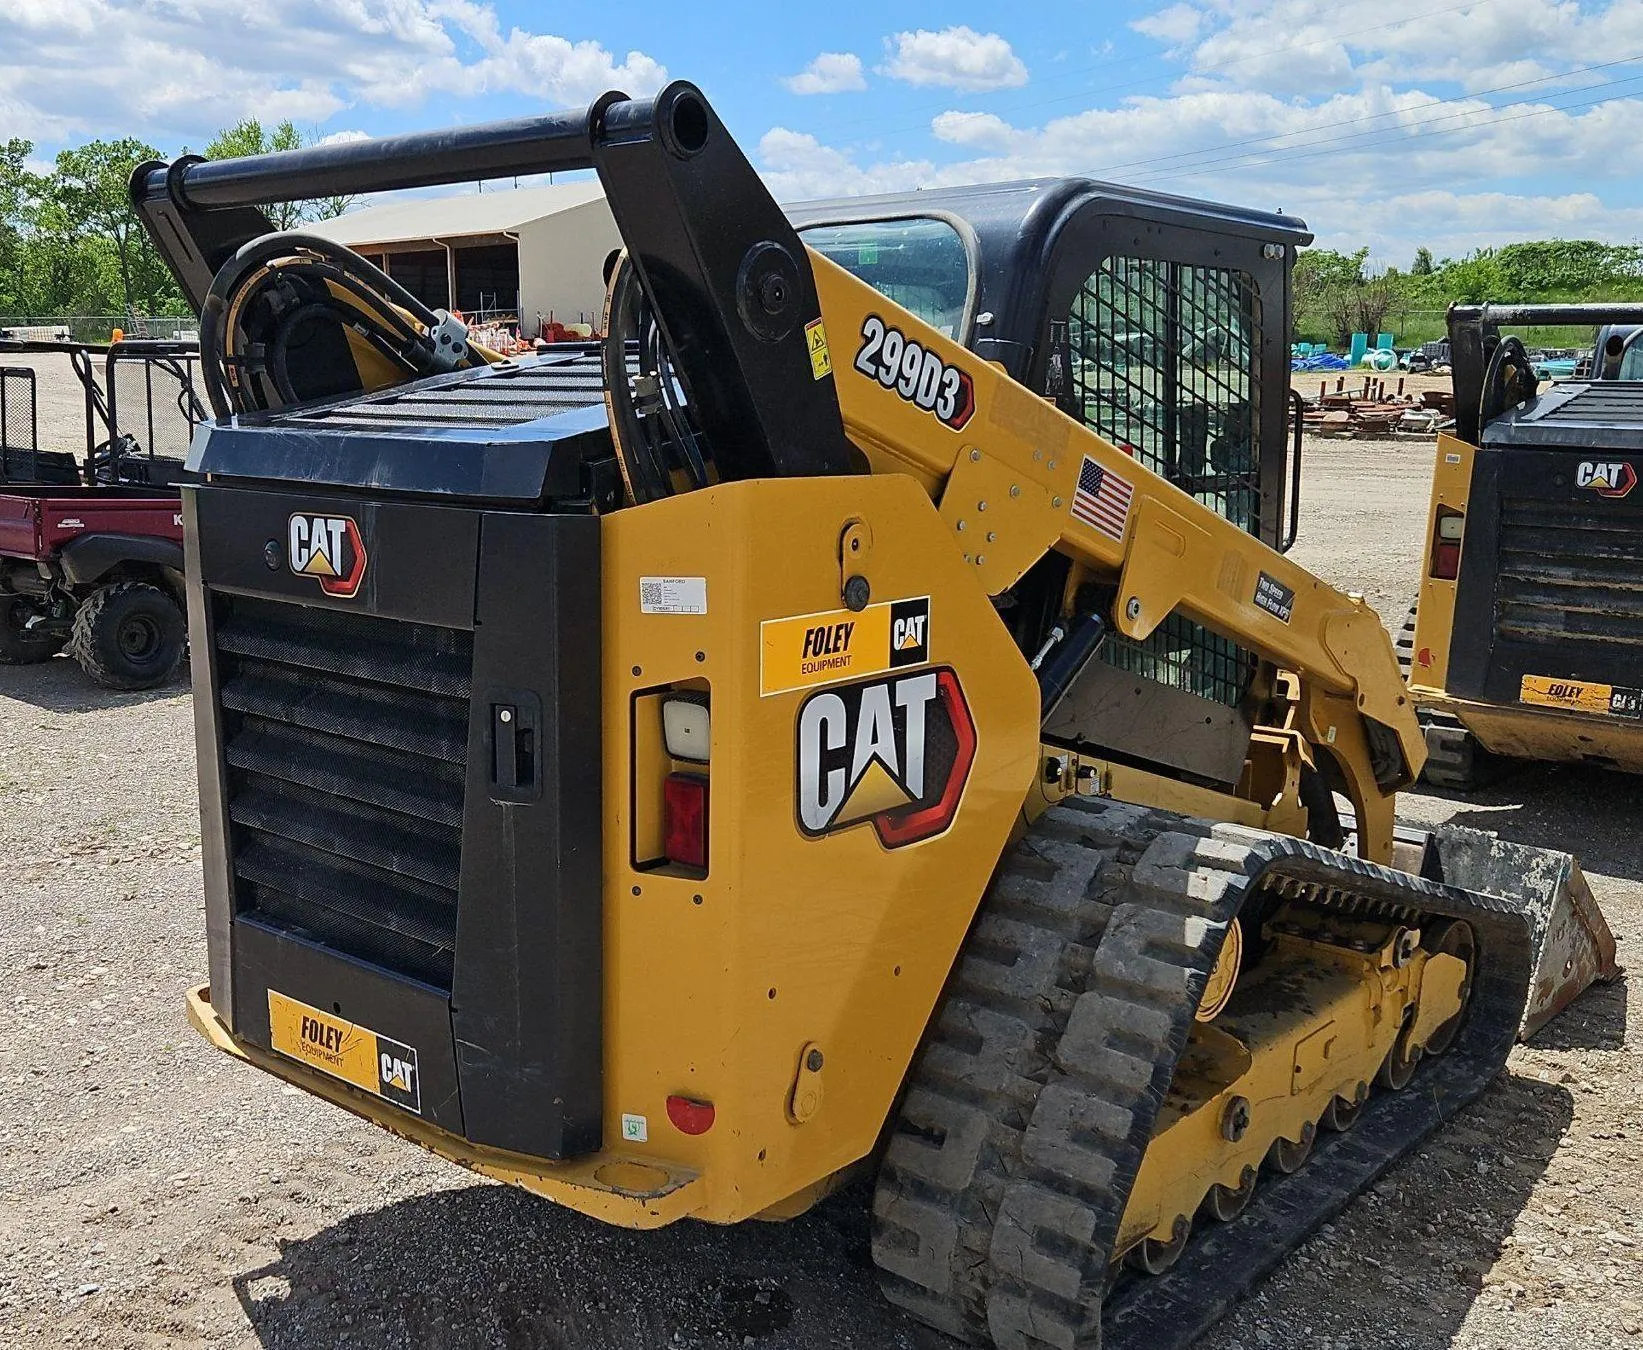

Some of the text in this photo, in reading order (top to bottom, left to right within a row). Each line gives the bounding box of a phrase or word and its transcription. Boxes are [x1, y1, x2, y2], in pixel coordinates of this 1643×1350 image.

[857, 317, 960, 420] 299D3
[1577, 462, 1623, 488] CAT
[290, 515, 346, 576] CAT
[802, 622, 855, 659] FOLEY
[893, 615, 925, 650] CAT
[801, 655, 852, 675] EQUIPMENT
[801, 673, 936, 830] CAT
[301, 1016, 343, 1053] FOLEY
[301, 1042, 344, 1067] EQUIPMENT
[381, 1053, 413, 1093] CAT
